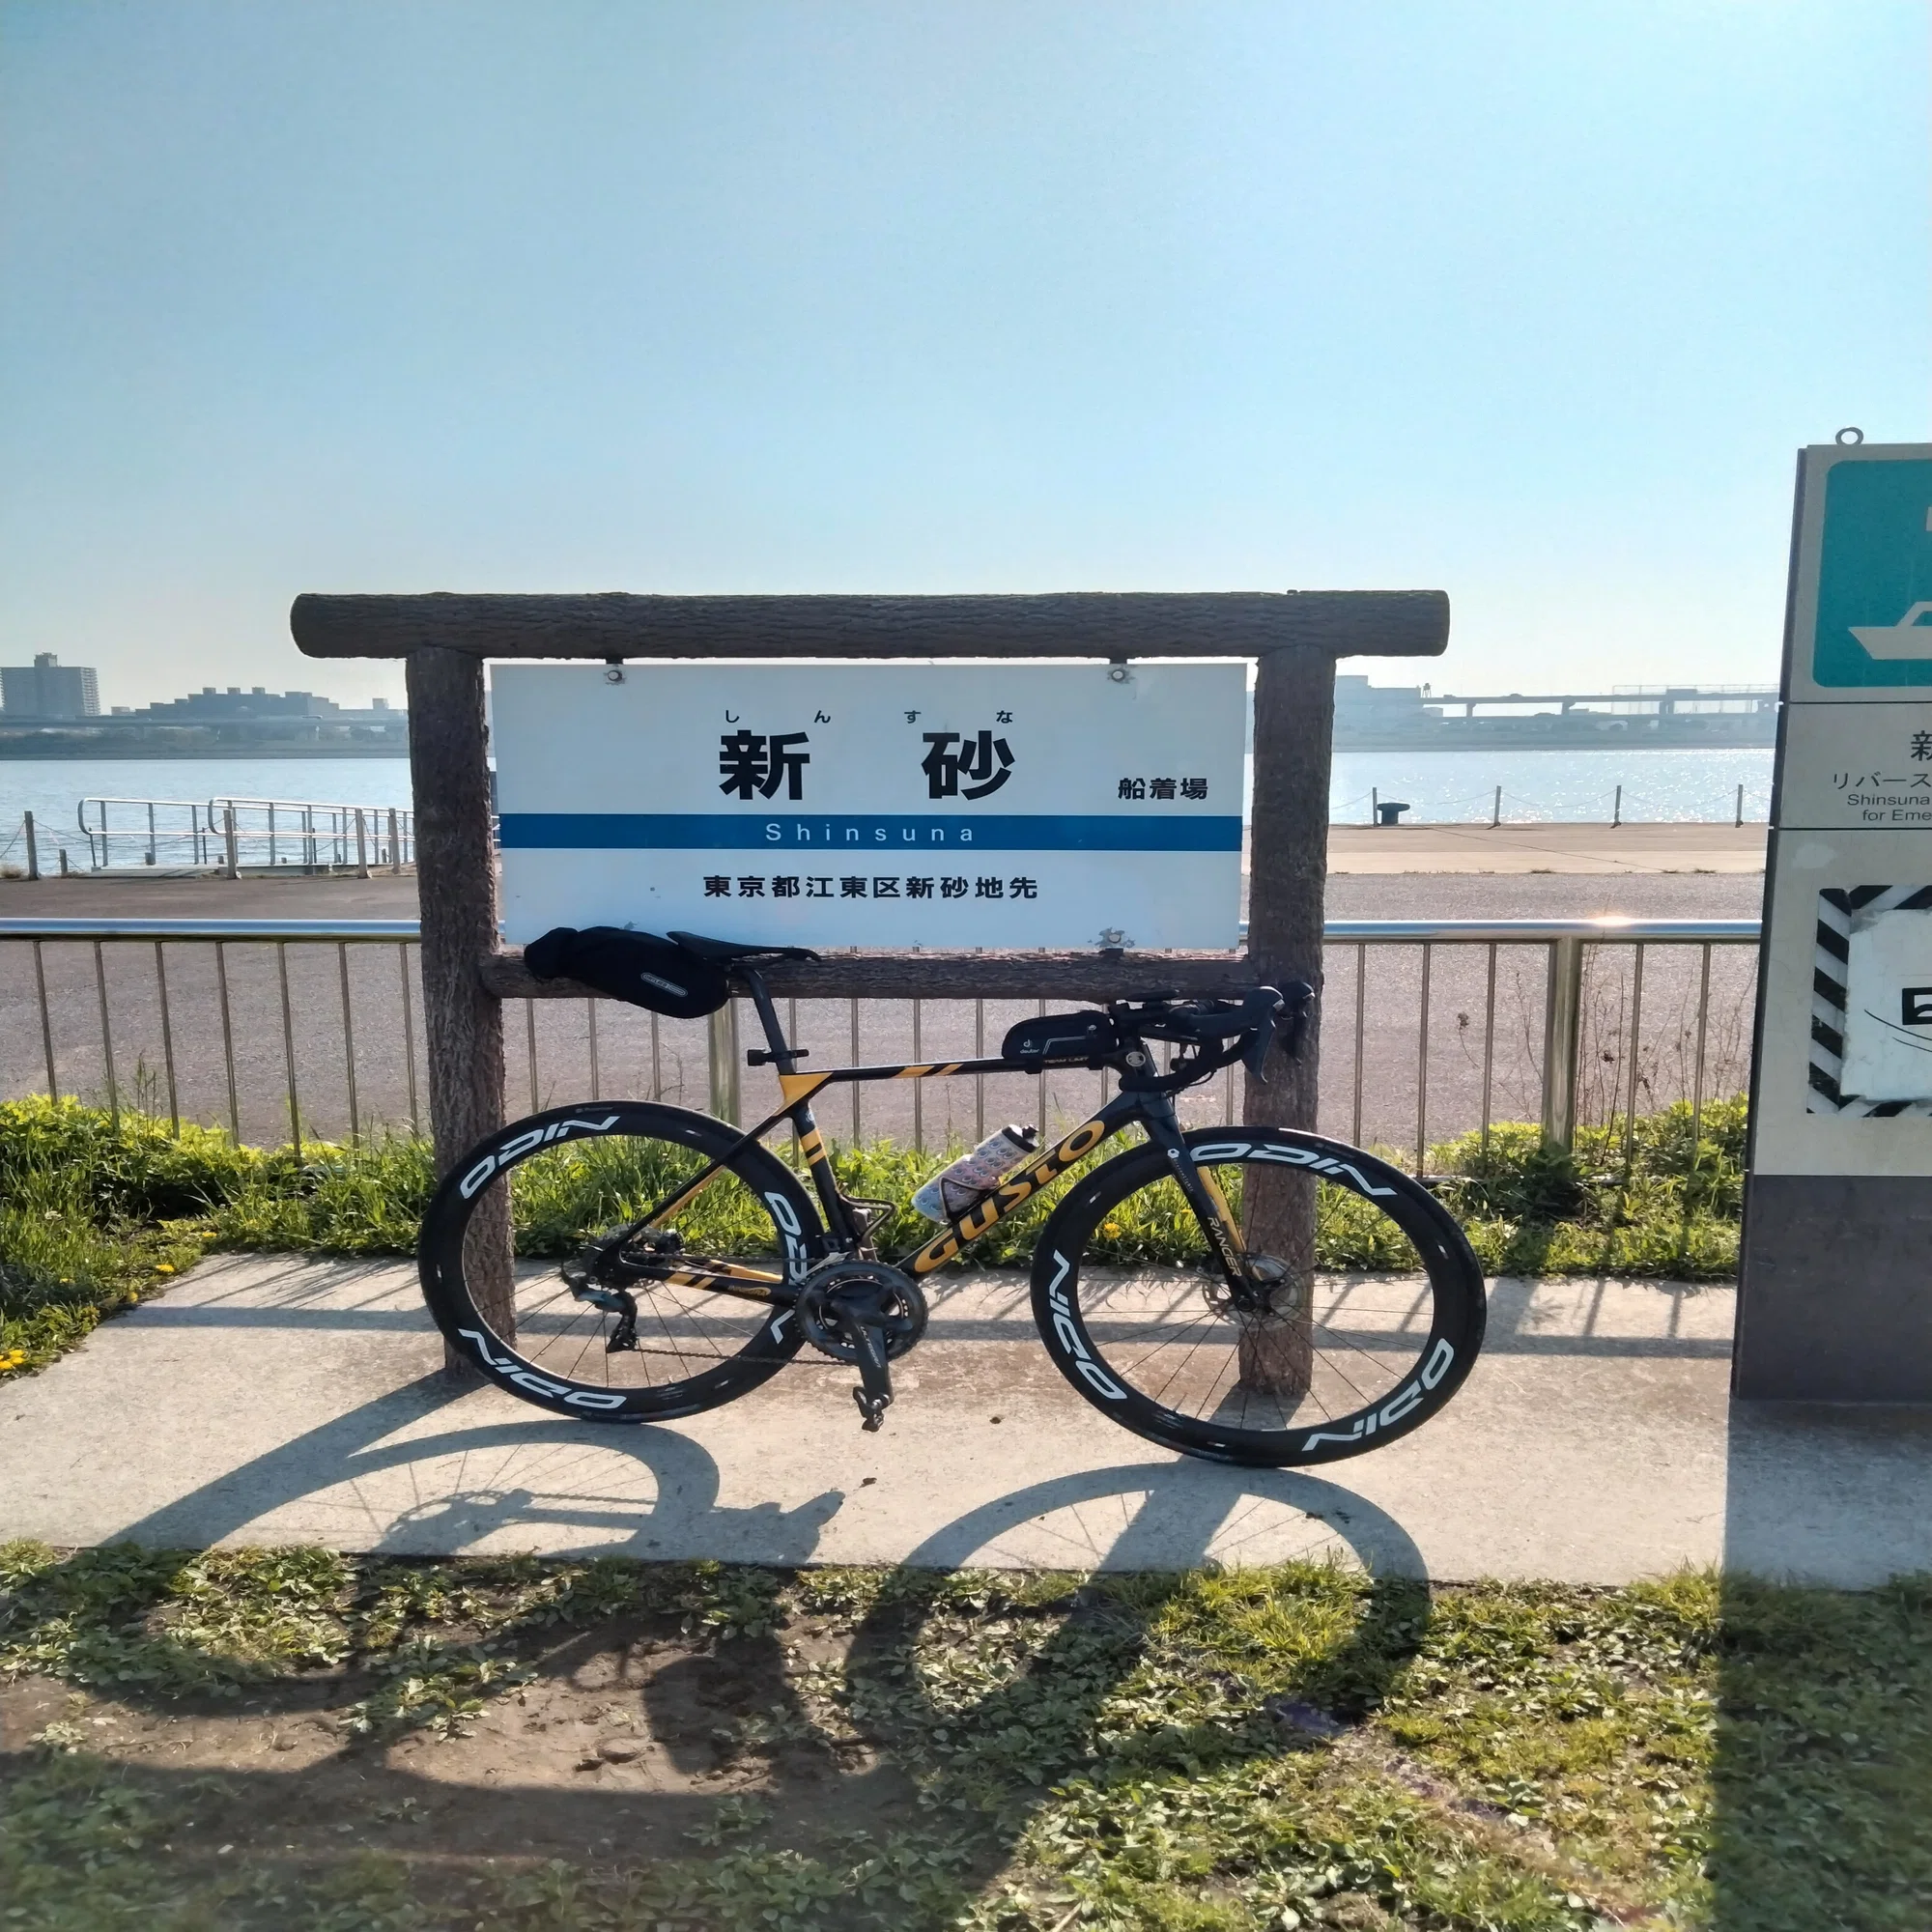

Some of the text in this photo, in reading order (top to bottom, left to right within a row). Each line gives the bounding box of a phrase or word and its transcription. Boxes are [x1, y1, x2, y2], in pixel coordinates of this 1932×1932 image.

[1118, 777, 1208, 801] 船着場
[1833, 770, 1932, 790] リバース
[1847, 793, 1930, 807] Shinsuna
[1862, 809, 1932, 822] for Eme
[765, 822, 974, 842] Shinsuna
[702, 874, 1038, 899] 東京都江東区新砂地先
[1207, 1216, 1243, 1277] RANGER
